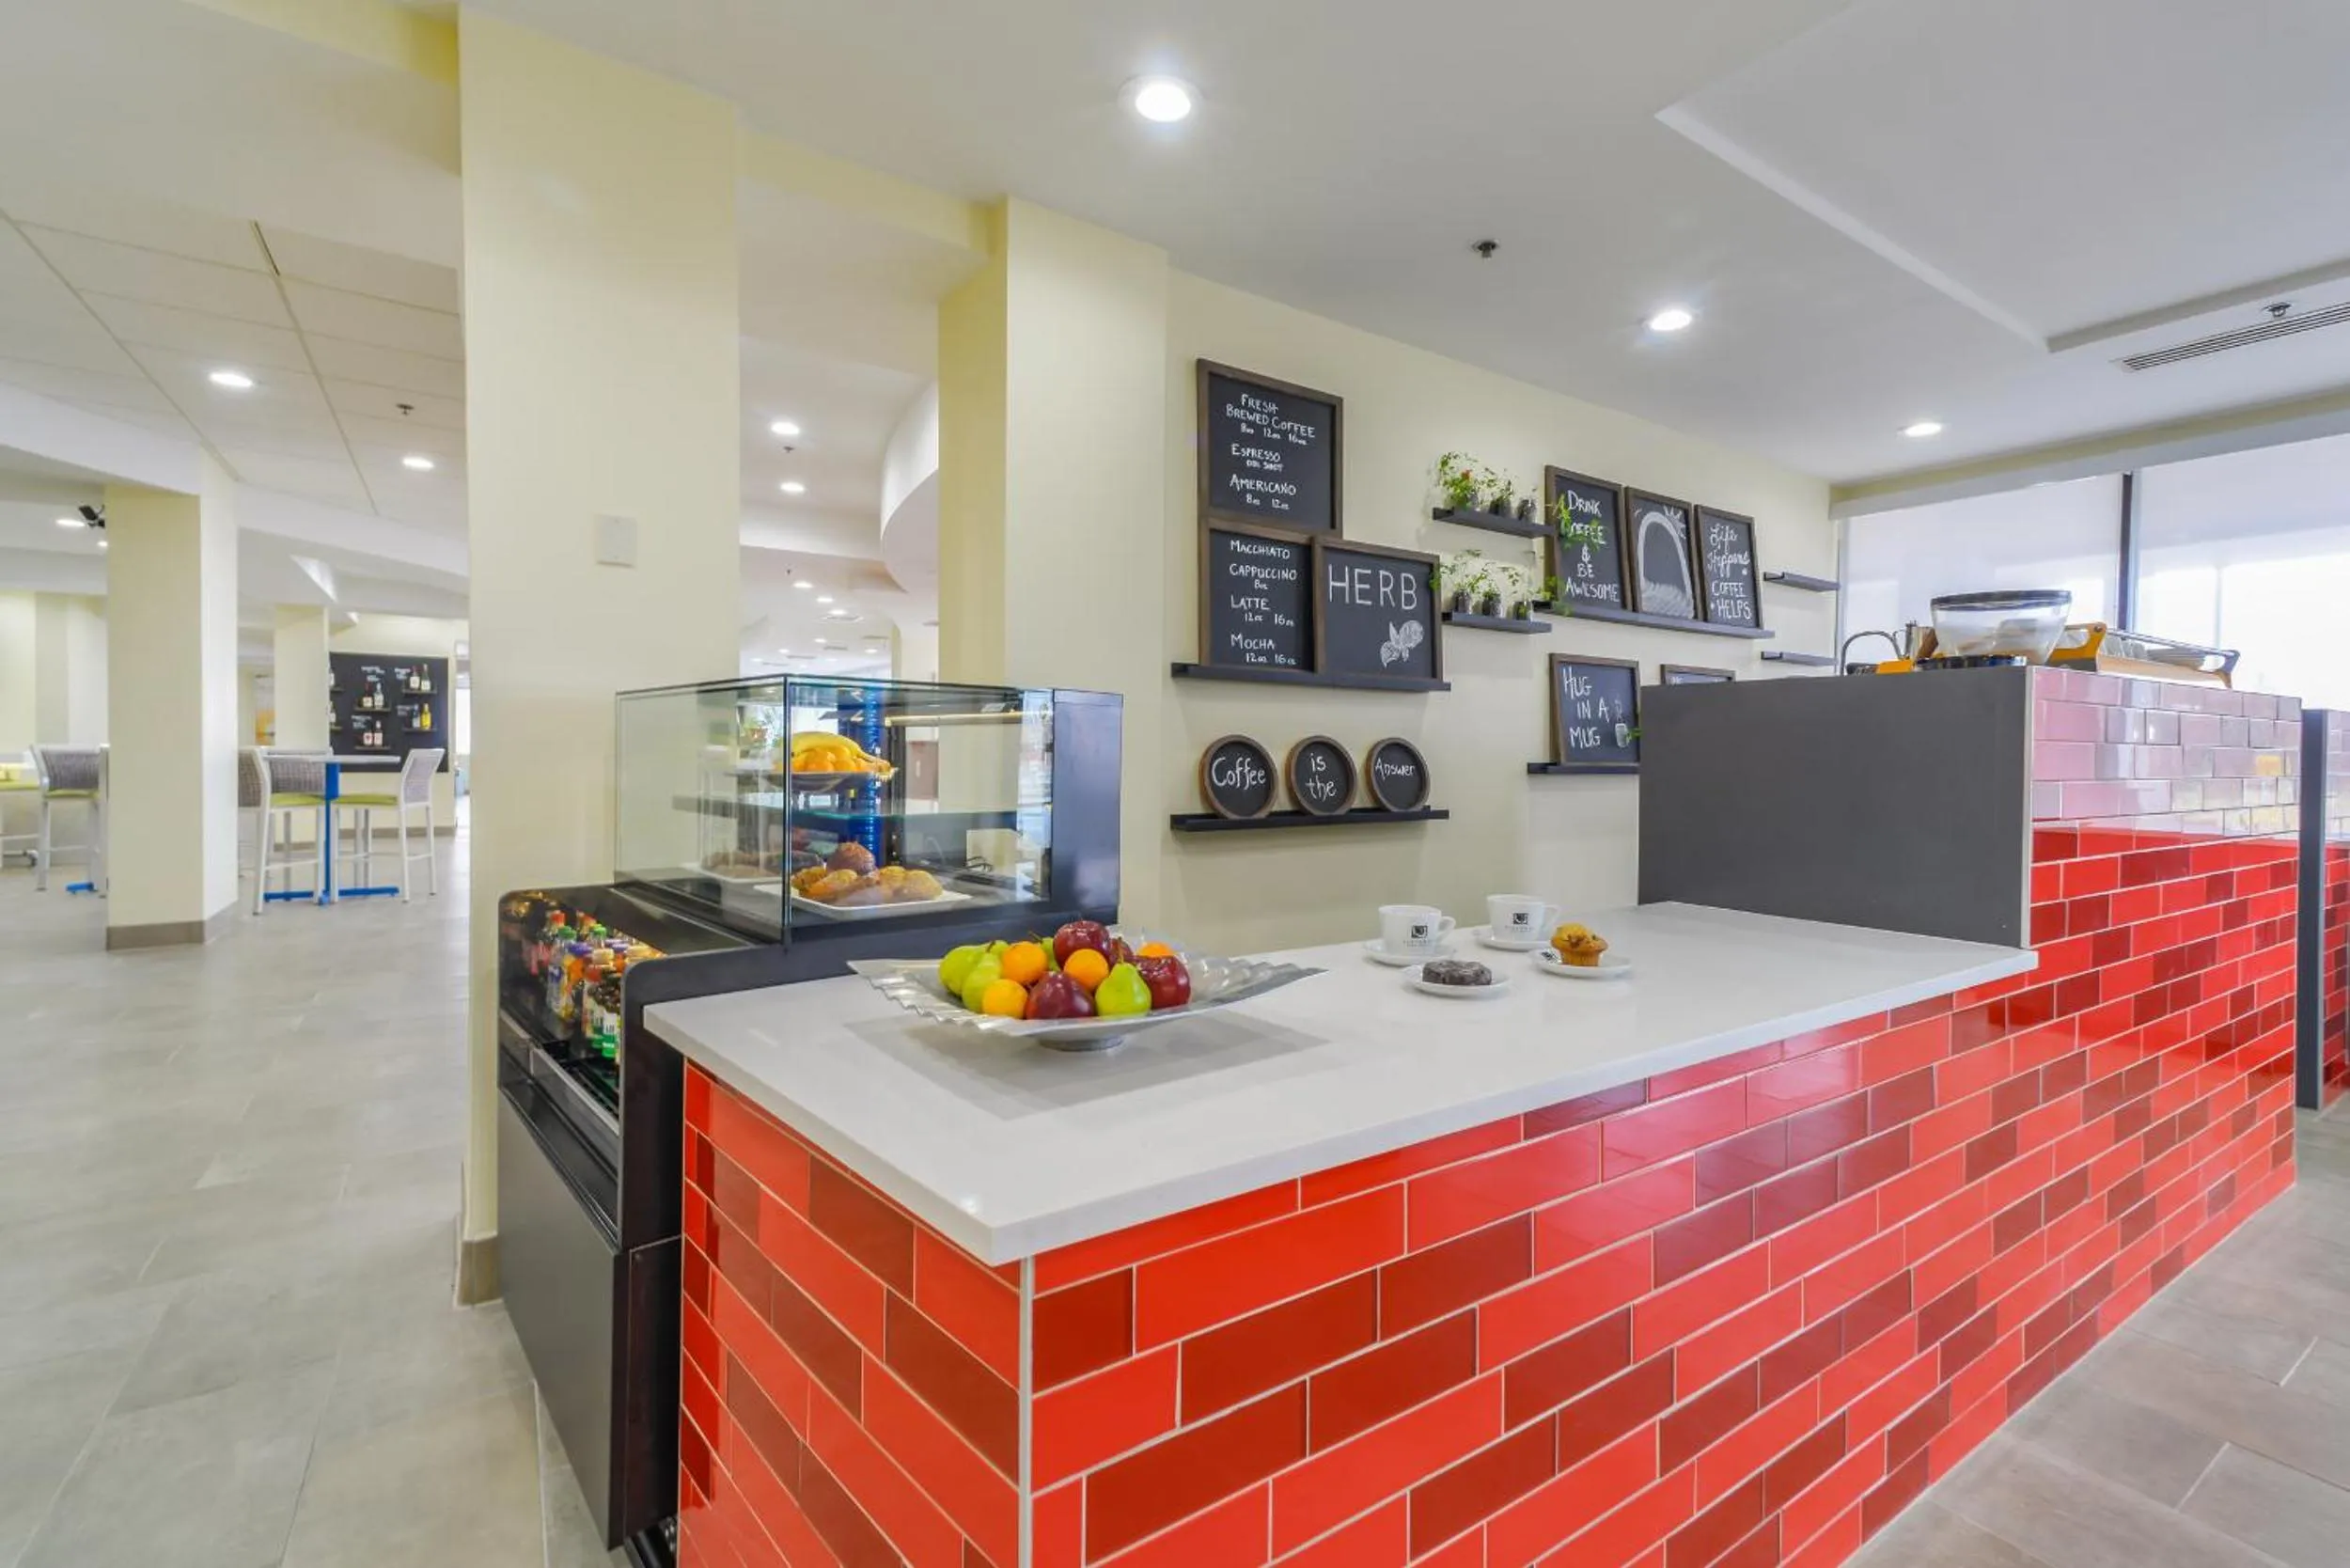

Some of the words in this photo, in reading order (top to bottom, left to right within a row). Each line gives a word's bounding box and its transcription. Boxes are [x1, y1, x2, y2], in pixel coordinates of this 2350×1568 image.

[1241, 394, 1278, 414] FRESH
[1226, 403, 1269, 425] BREWED
[1272, 416, 1315, 438] COFFEE
[1230, 443, 1280, 463] ESPRESSO
[1230, 474, 1296, 495] AMERICANO
[1568, 490, 1602, 517] DRINK
[1230, 540, 1291, 559] MACCHIATO
[1230, 563, 1297, 581] CAPPUCCINO
[1577, 563, 1594, 578] BE
[1328, 564, 1418, 610] HERB
[1565, 576, 1620, 603] AWESOME
[1712, 580, 1747, 598] COFFEE
[1230, 594, 1270, 610] LATTE
[1716, 599, 1752, 619] HELPS
[1230, 633, 1276, 651] MOCHA
[1563, 666, 1592, 699] HUG
[1577, 698, 1590, 719] IN
[1598, 697, 1609, 722] A
[1569, 727, 1601, 748] MUG
[1212, 757, 1267, 790] Coffee
[1310, 753, 1326, 773] is
[1375, 756, 1416, 781] Answer
[1306, 775, 1337, 801] the
